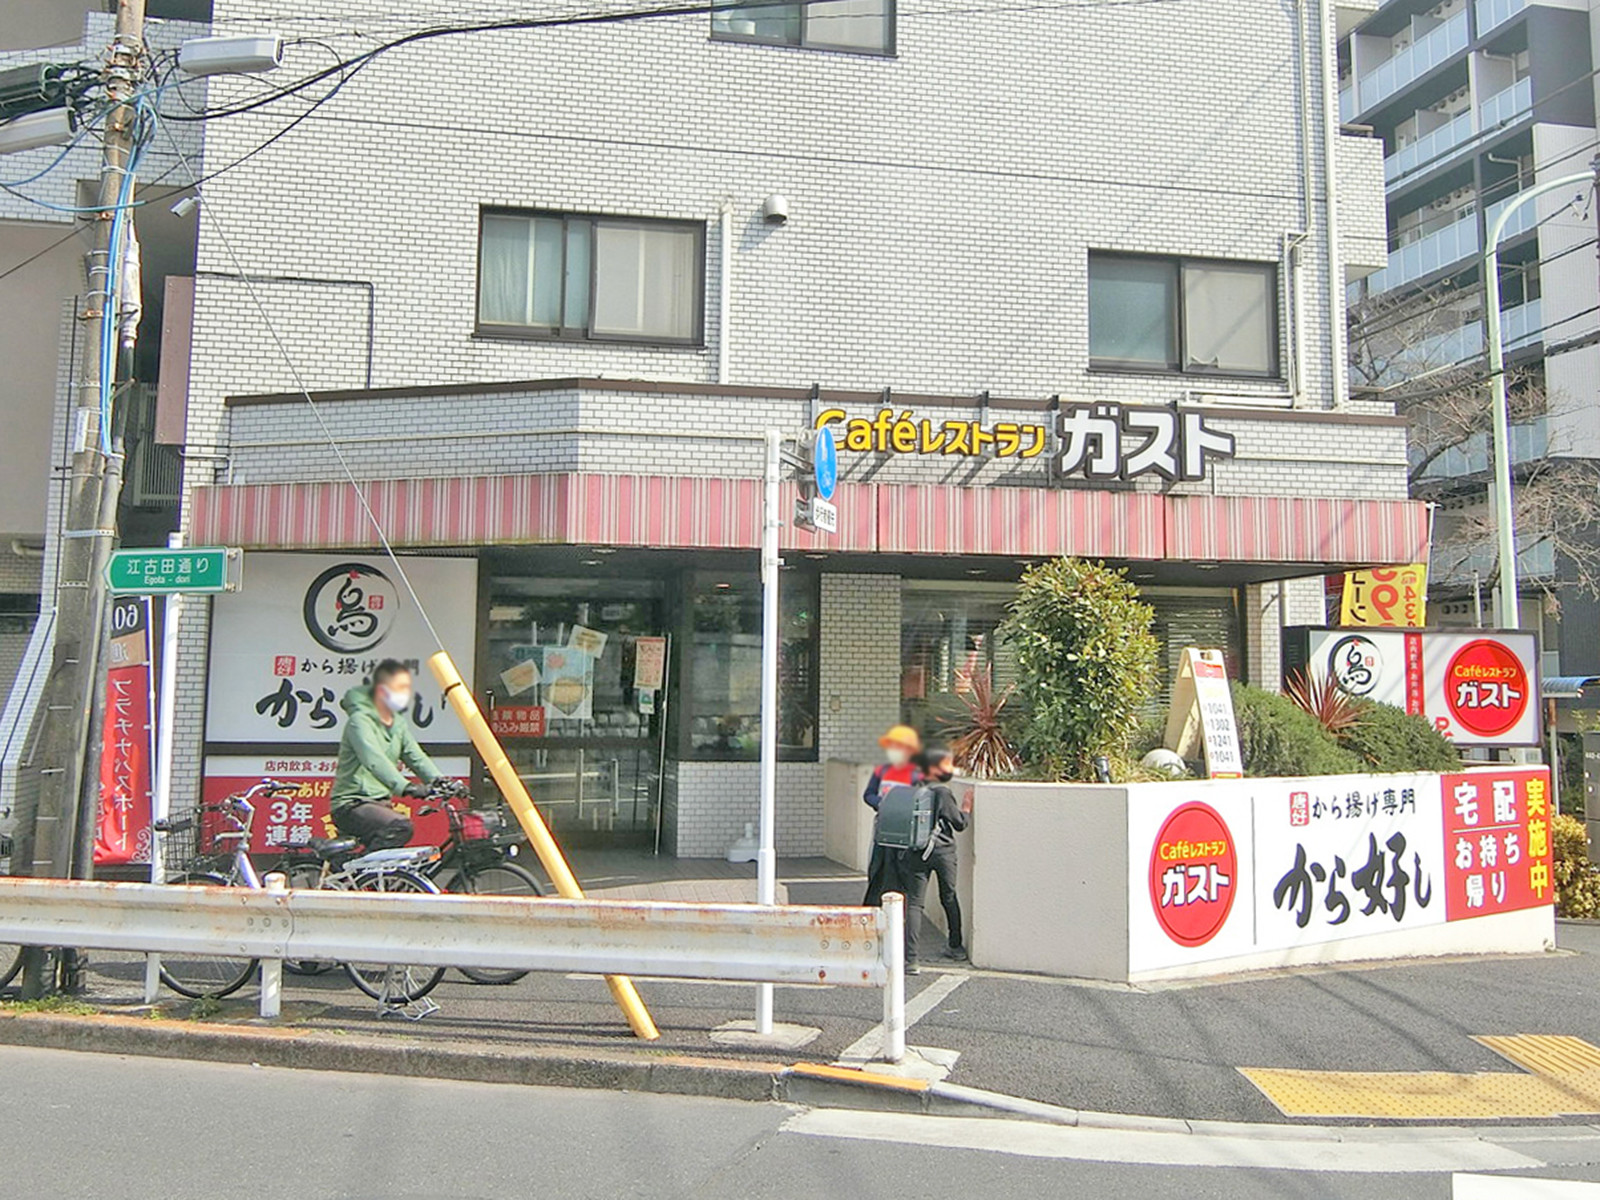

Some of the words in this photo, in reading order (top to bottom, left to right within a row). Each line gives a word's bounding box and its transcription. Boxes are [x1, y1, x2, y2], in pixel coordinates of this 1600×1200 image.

[1060, 404, 1234, 479] ガスト
[127, 557, 209, 575] 江古田通り
[144, 576, 166, 585] Egota
[256, 678, 434, 730] からし
[1456, 681, 1521, 709] ガスト
[269, 801, 313, 823] 3年
[1313, 788, 1415, 820] から揚げ専門
[1454, 780, 1518, 826] 宅配
[265, 825, 313, 846] 連続
[1455, 832, 1521, 869] お持ち
[1526, 778, 1548, 899] 実施中
[1161, 863, 1231, 908] ガスト
[1273, 831, 1432, 929] から好し
[1466, 870, 1506, 908] 帰り
